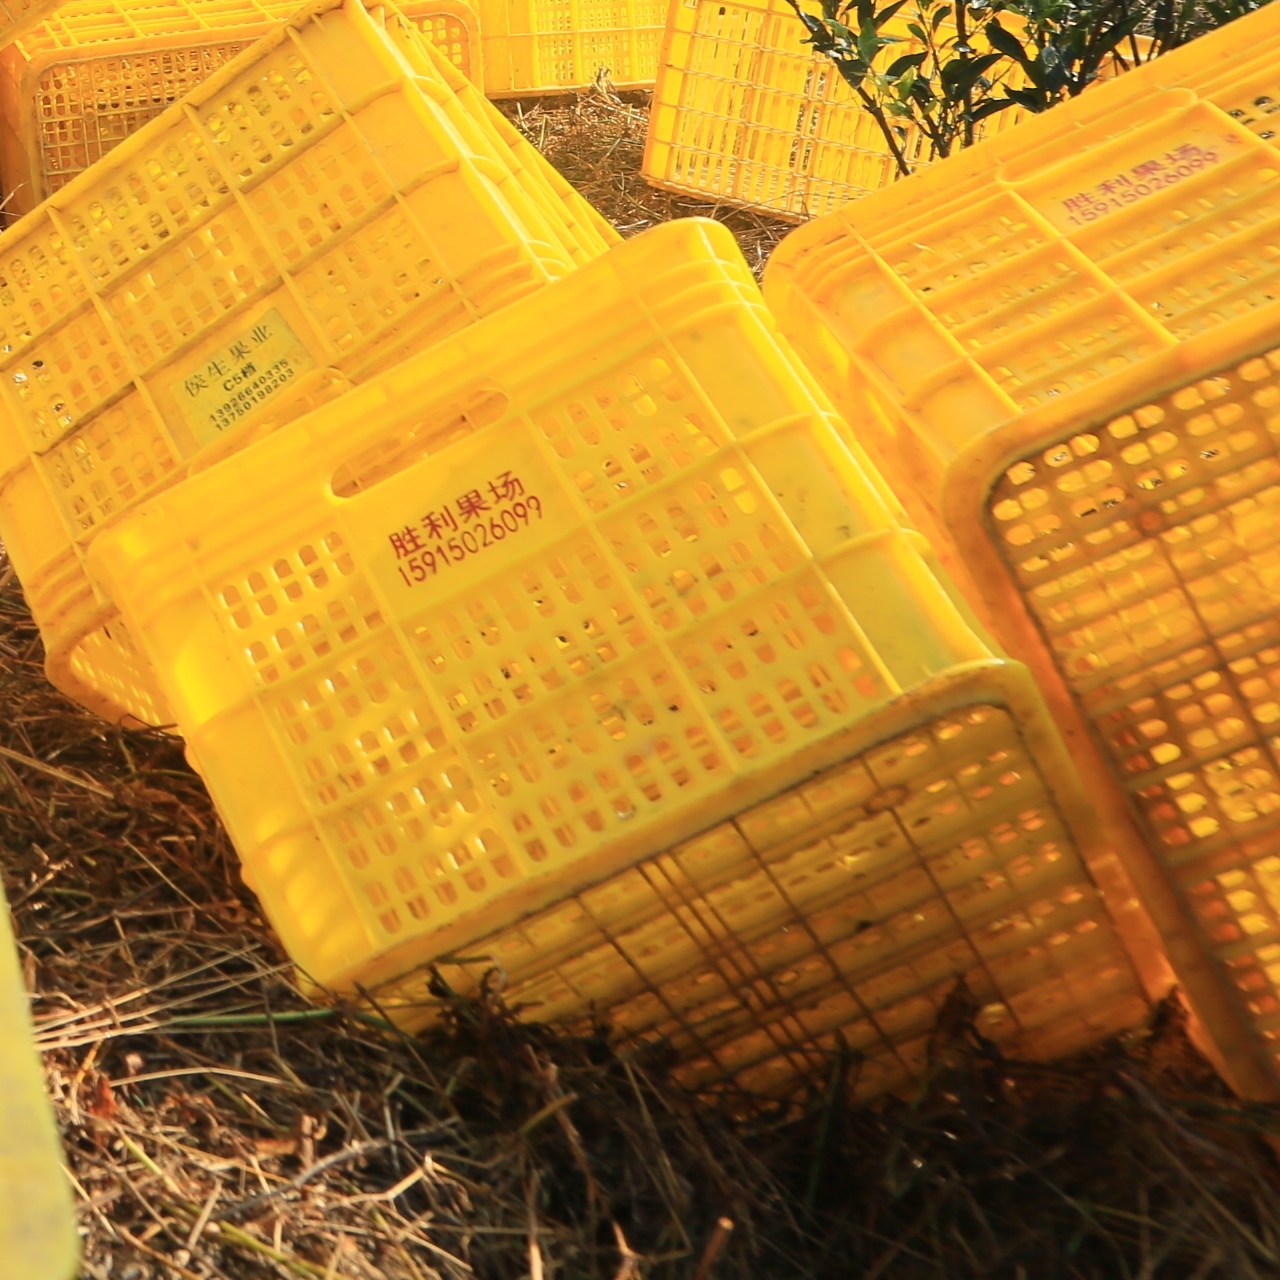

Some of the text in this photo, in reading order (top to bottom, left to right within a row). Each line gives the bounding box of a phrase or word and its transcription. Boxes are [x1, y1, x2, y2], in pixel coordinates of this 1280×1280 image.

[1062, 143, 1205, 212] 胜利果场
[1068, 151, 1219, 226] 15915026099
[209, 359, 289, 422] 13926640335
[215, 368, 294, 431] 13750198203
[223, 362, 257, 392] C5档
[388, 470, 526, 560] 胜利果场
[398, 495, 543, 588] 15915026099
